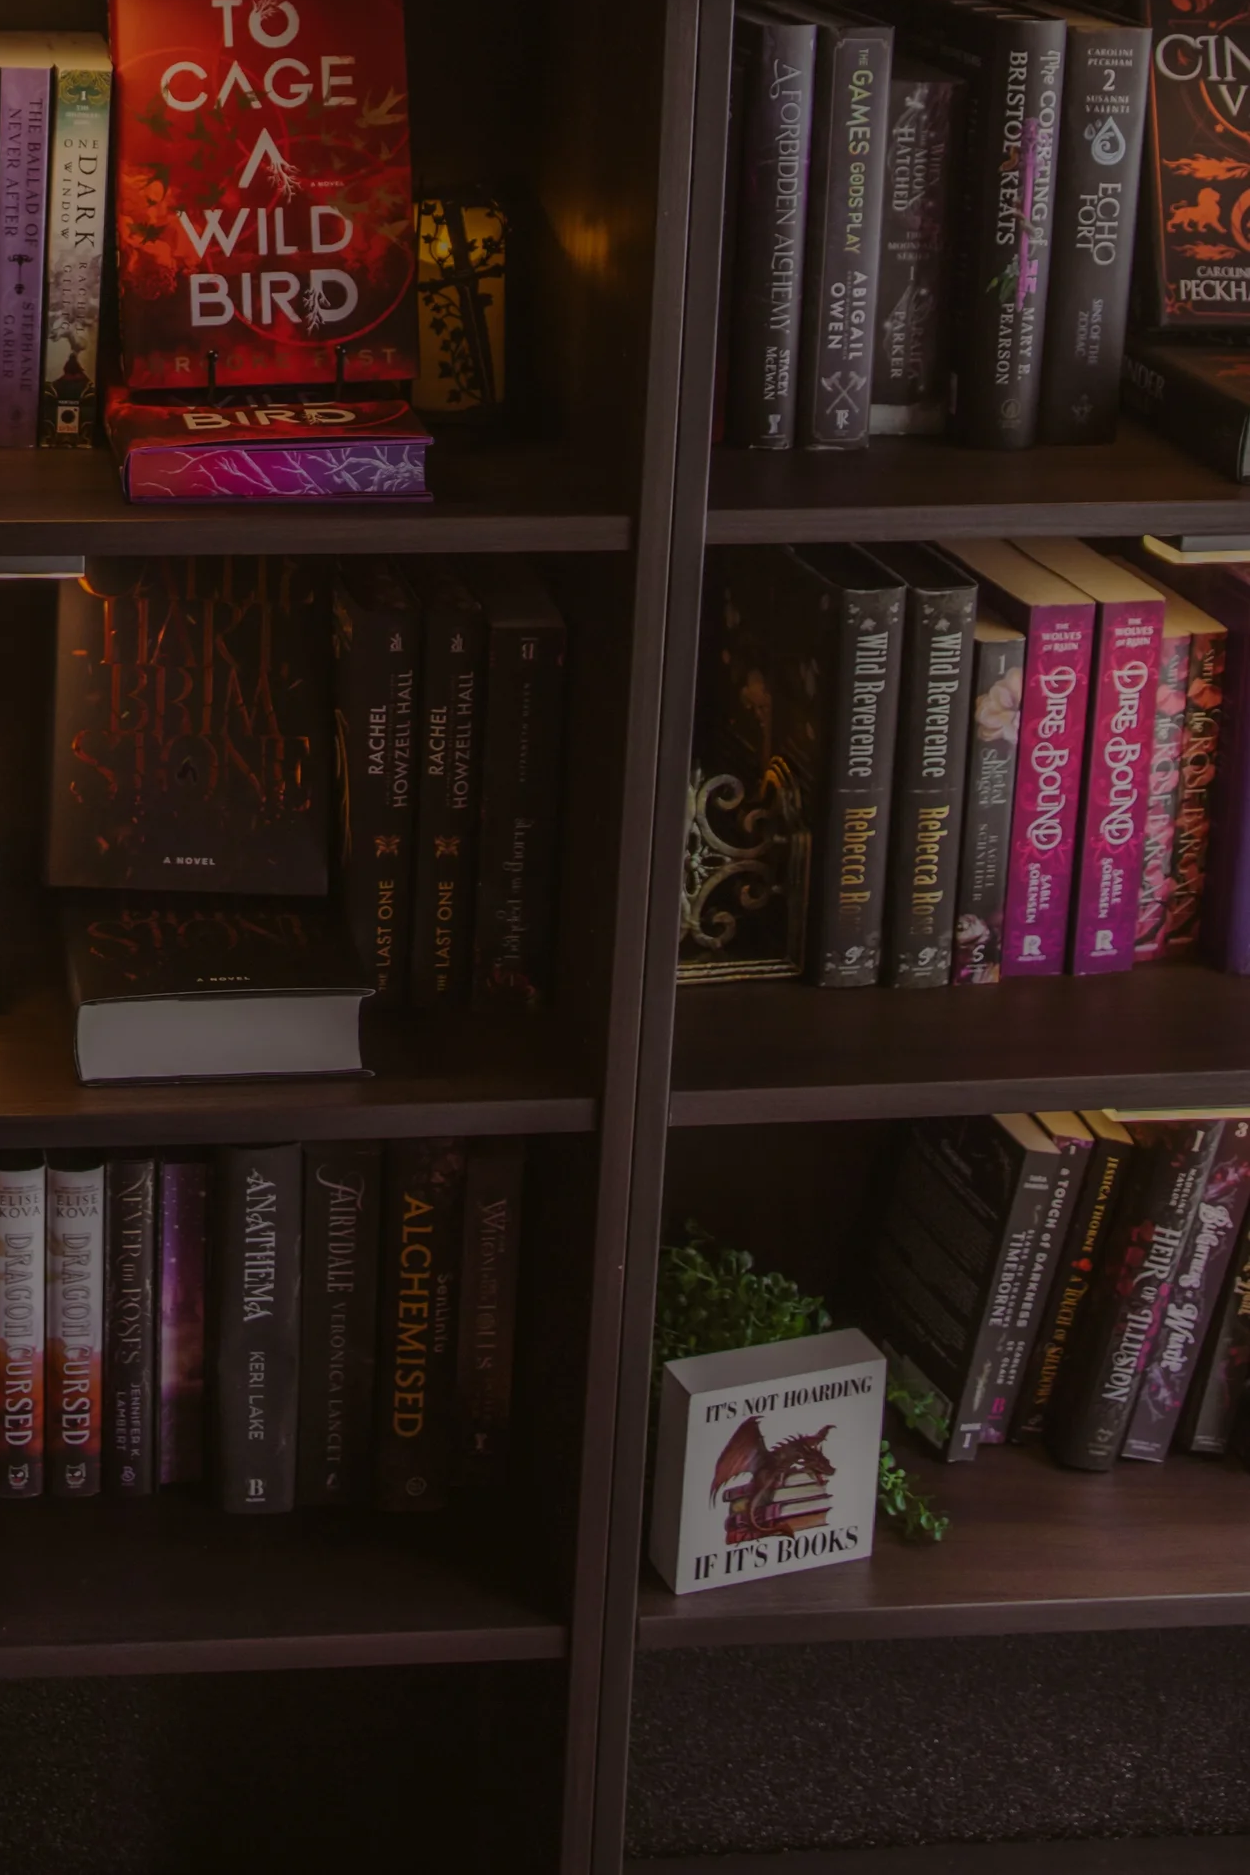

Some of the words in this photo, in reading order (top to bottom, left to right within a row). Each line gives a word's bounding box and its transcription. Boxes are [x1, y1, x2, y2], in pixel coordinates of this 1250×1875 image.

[160, 55, 357, 113] CAGE
[849, 69, 874, 154] GAMES
[1002, 50, 1029, 153] BRISTOL
[63, 138, 99, 149] ONE
[61, 161, 74, 240] WINDOW
[77, 154, 97, 248] DARK
[178, 205, 353, 258] WILD
[996, 170, 1020, 245] KEATS
[1076, 194, 1099, 249] FORT
[1092, 182, 1122, 266] ECHO
[845, 208, 862, 256] PLAY
[189, 269, 359, 335] BIRD
[855, 631, 889, 675] Wild
[846, 680, 886, 778] Reverence
[1041, 665, 1076, 735] DIRE
[1031, 741, 1069, 851] BOUND
[378, 879, 395, 920] ONE
[376, 927, 392, 968] LAST
[243, 1168, 277, 1324] ANATHEMA
[392, 1194, 434, 1439] ALCHEMISED
[249, 1350, 265, 1390] KERI
[705, 1401, 737, 1423] IT'S
[742, 1392, 780, 1417] NOT
[783, 1375, 873, 1411] HOARDING
[248, 1394, 265, 1441] LAKE
[693, 1554, 719, 1580] IF
[723, 1542, 769, 1576] IT'S
[776, 1525, 859, 1562] BOOKS
